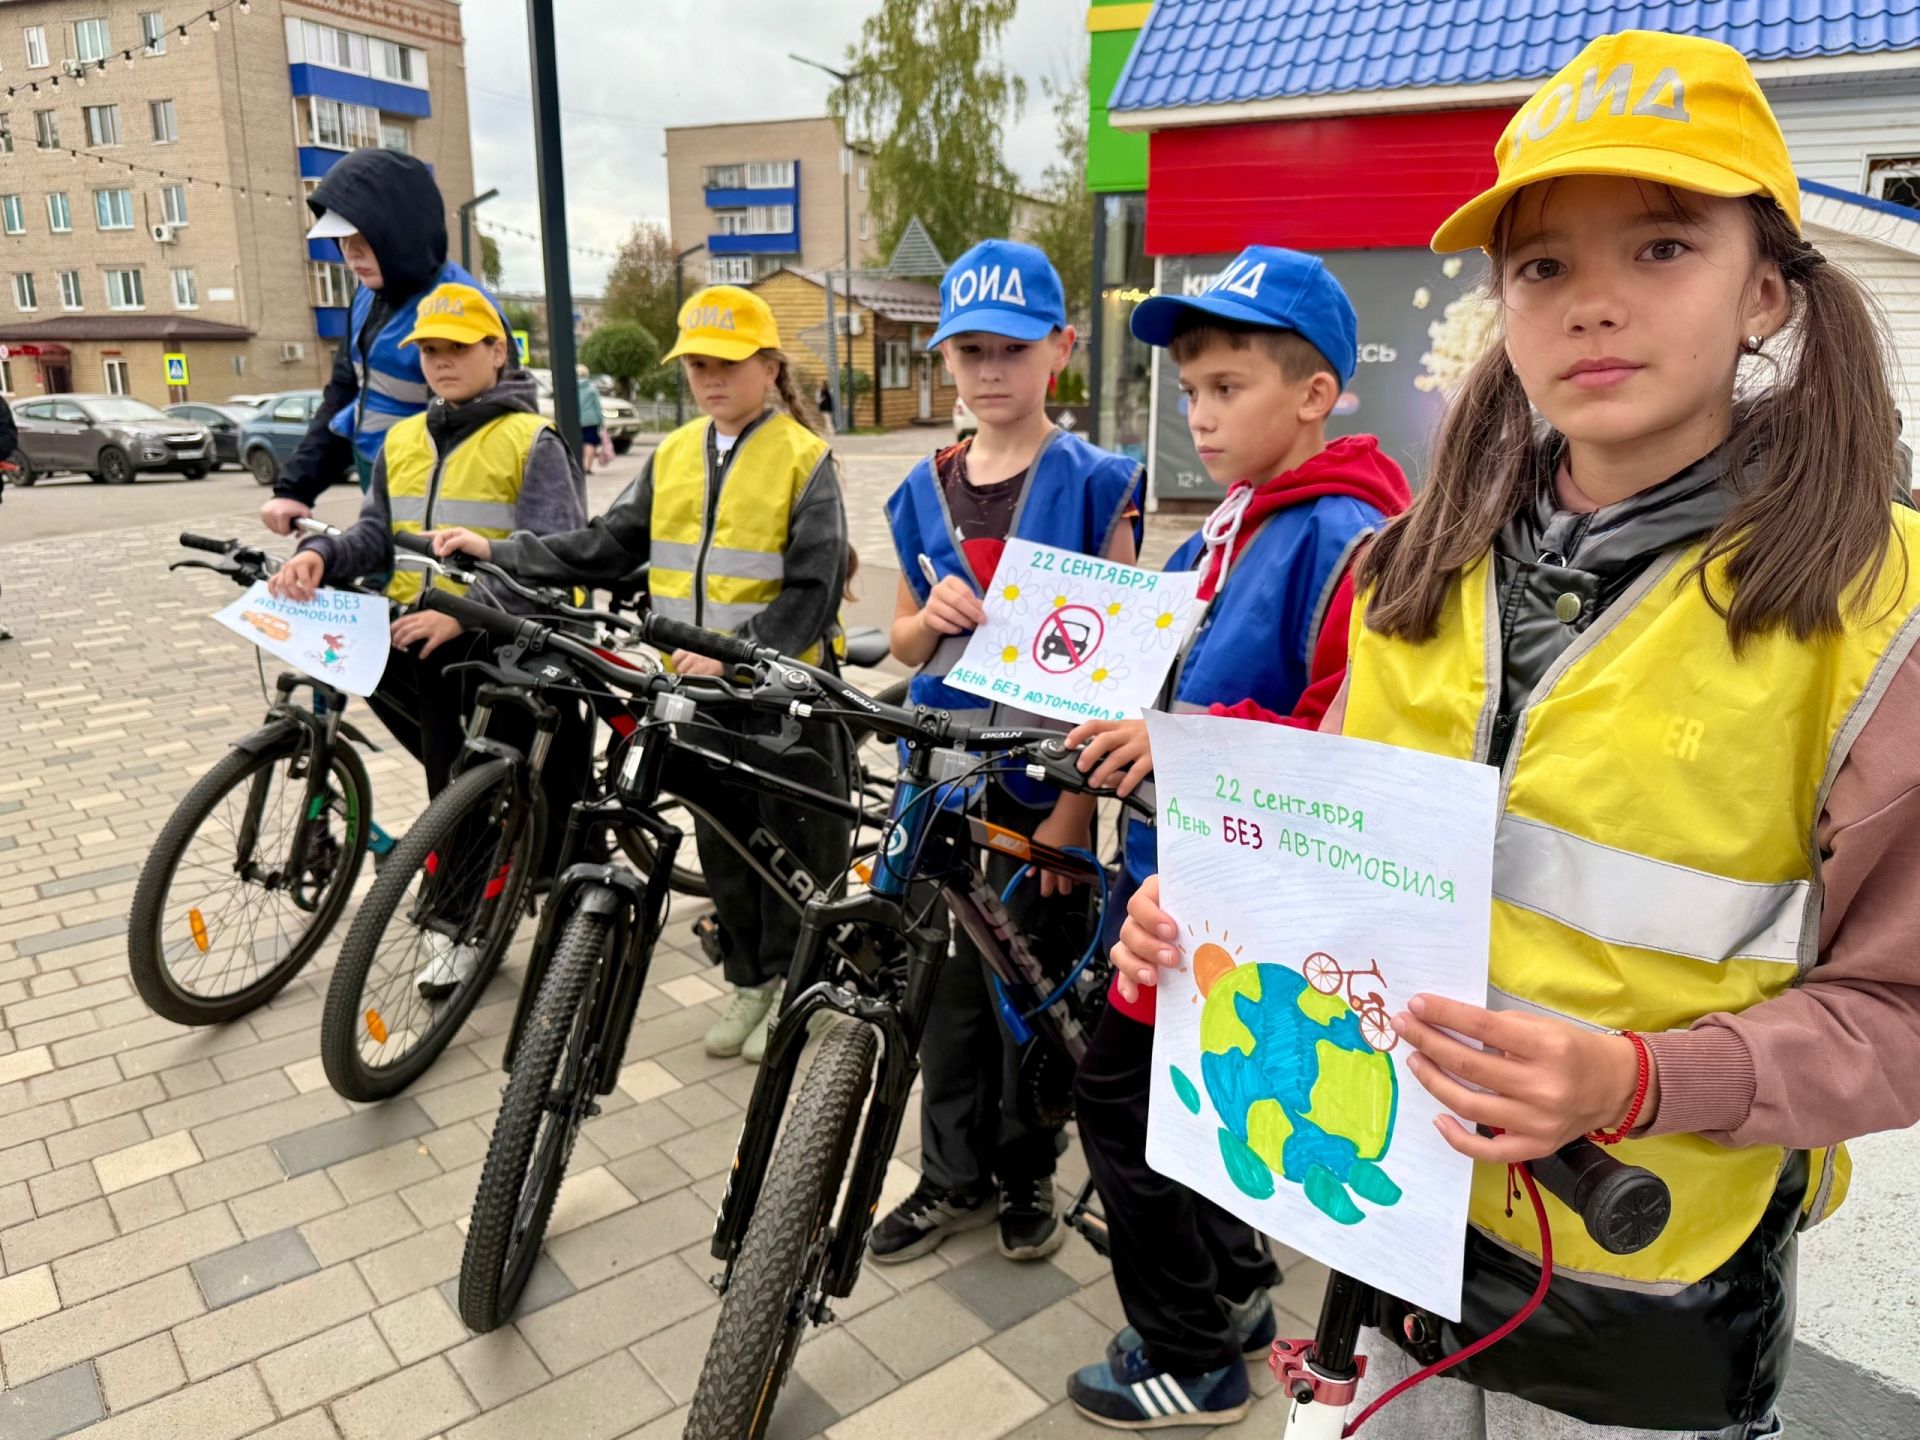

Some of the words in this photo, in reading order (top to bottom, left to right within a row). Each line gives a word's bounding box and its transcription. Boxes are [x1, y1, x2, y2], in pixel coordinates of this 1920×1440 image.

[1512, 63, 1690, 160] ЮИД
[951, 264, 1027, 313] ЮИД
[1030, 551, 1056, 572] 22
[1060, 559, 1159, 593] СЕНТЯБРЯ
[333, 593, 361, 610] БЕЗ
[949, 667, 988, 686] ДЕНЬ
[991, 678, 1021, 697] БЕЗ
[1023, 690, 1125, 721] АВТОМОБИЛЯ
[1215, 774, 1242, 803] 22
[1223, 815, 1263, 850] БЕЗ
[1279, 828, 1456, 903] АВТОМОБИЛЯ
